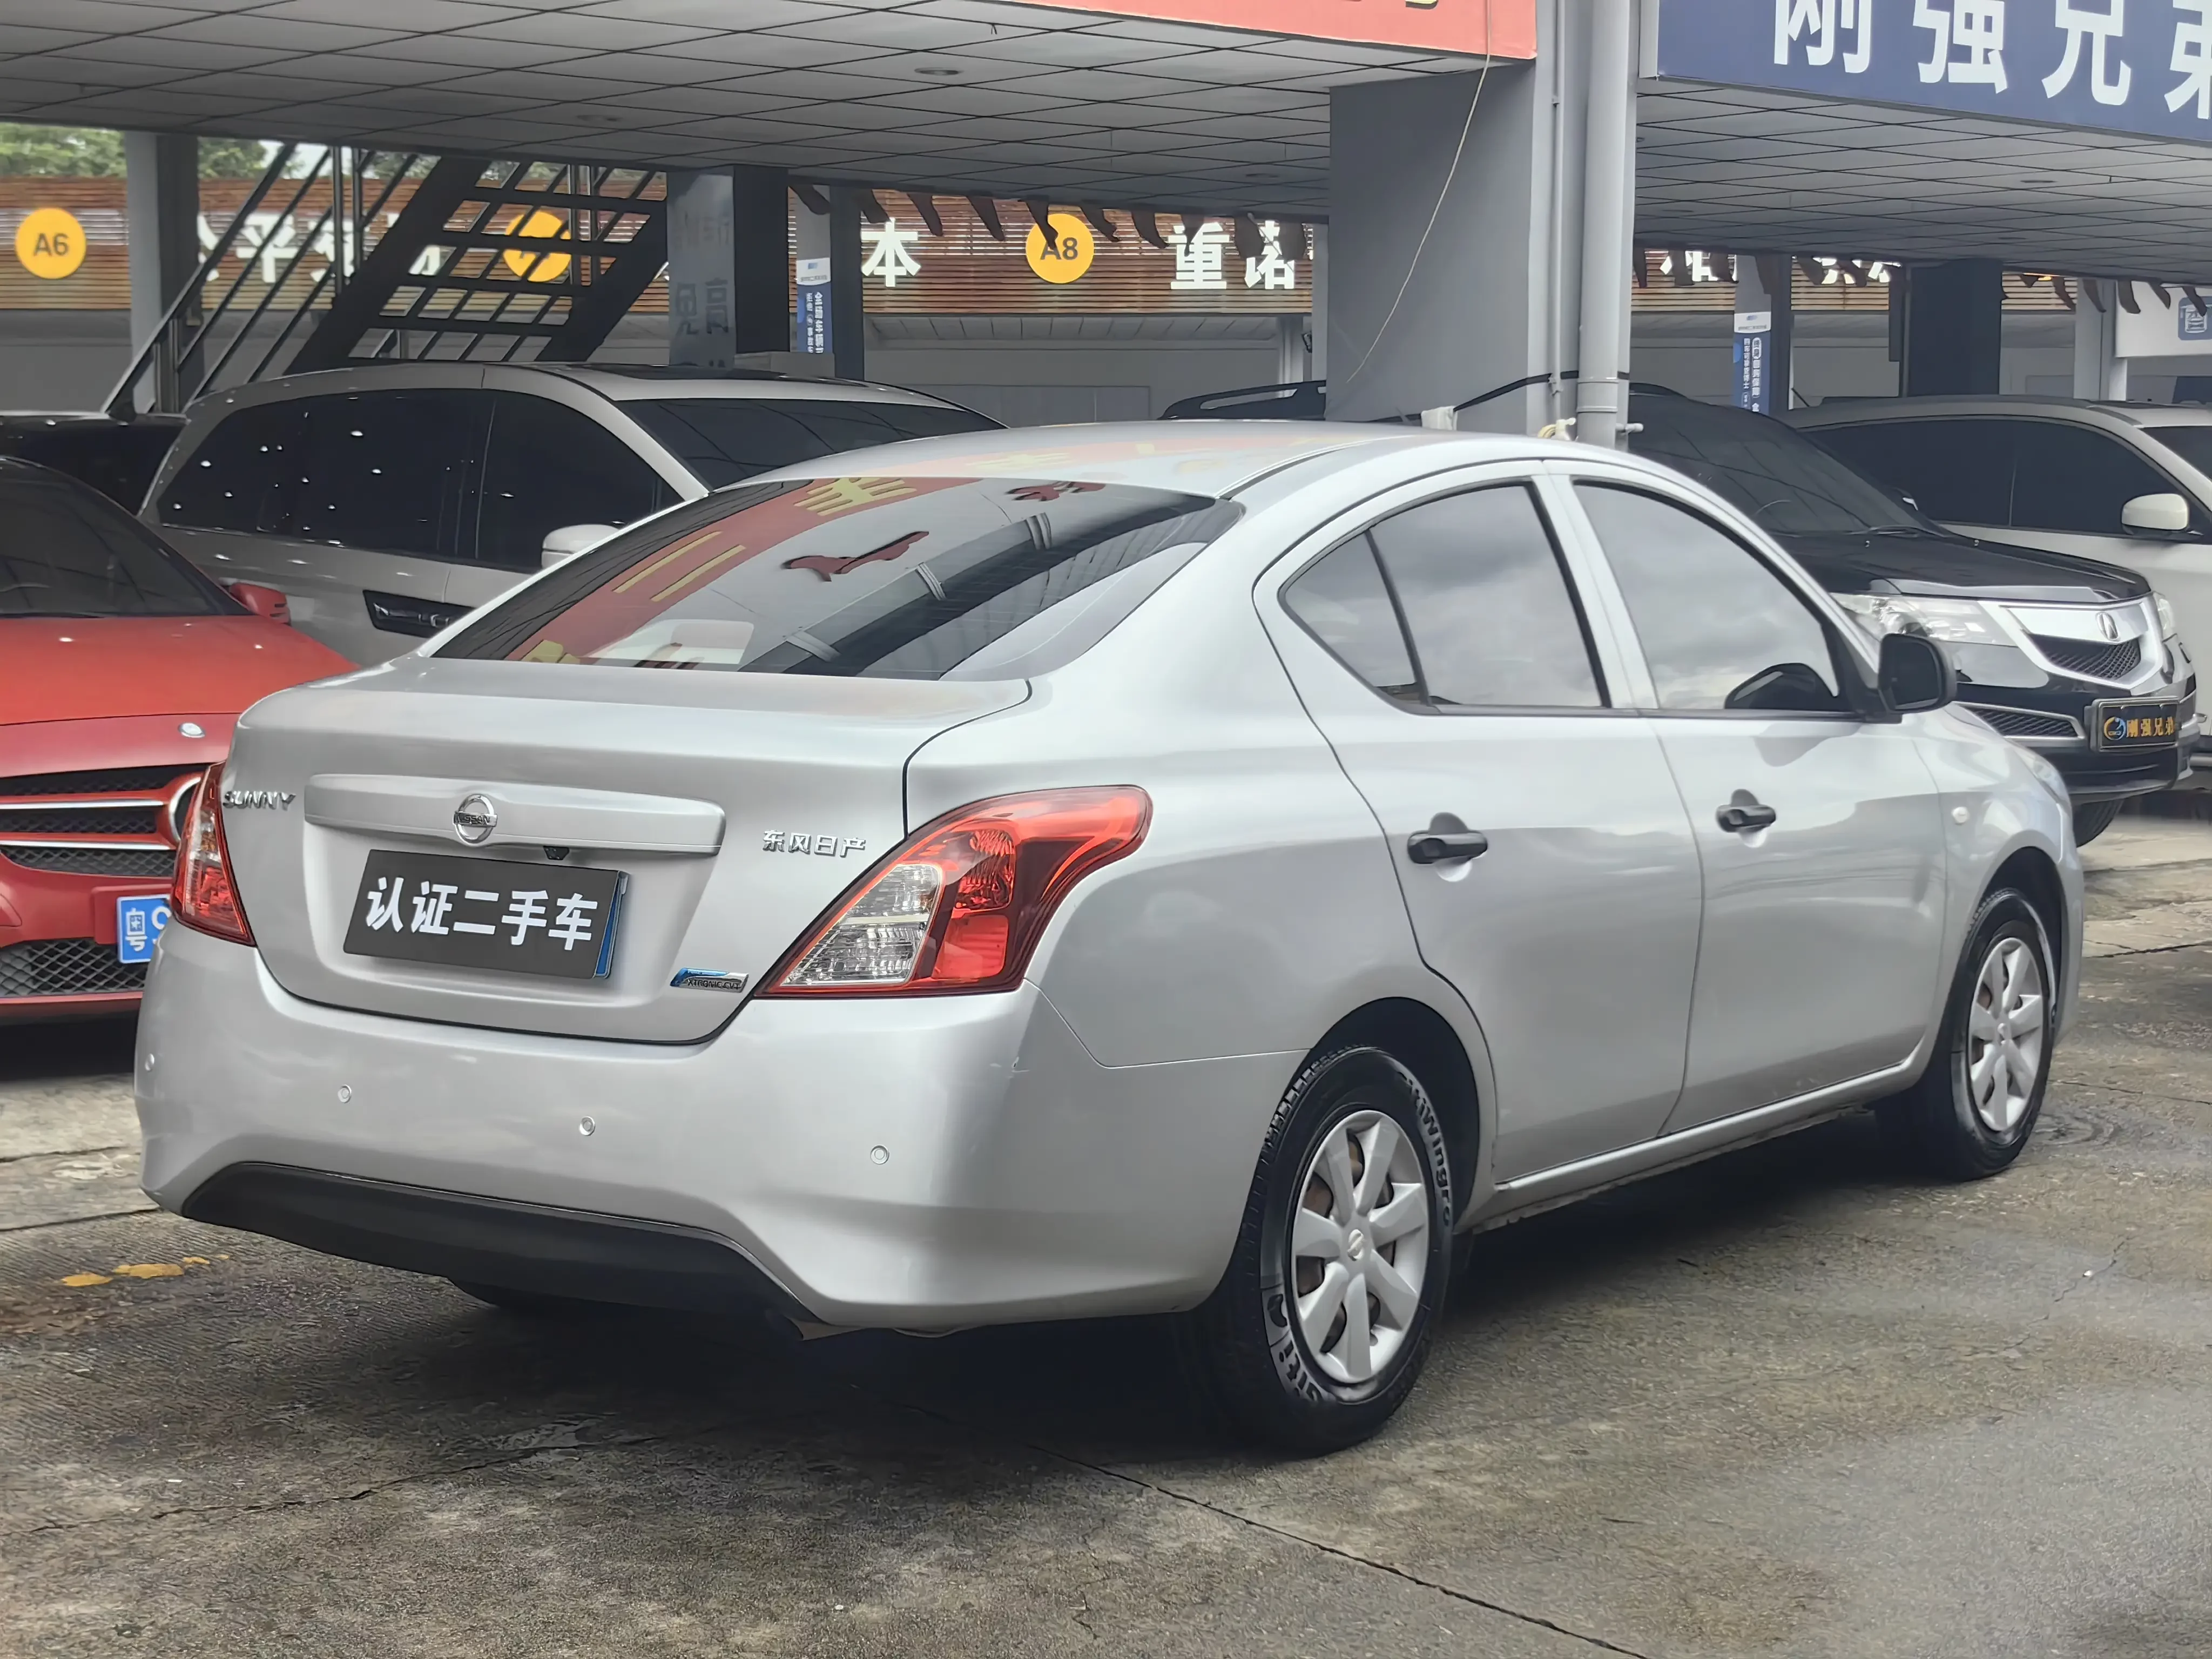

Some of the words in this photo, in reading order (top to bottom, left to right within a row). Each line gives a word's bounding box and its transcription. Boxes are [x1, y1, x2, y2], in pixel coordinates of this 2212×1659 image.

[33, 233, 70, 257] A6
[861, 218, 921, 287] 本
[1040, 237, 1078, 260] A8
[222, 791, 296, 811] SUNNY
[763, 830, 866, 858] 东风日产
[366, 876, 598, 951] 认证二手车
[687, 979, 721, 989] XTRONIC
[723, 982, 740, 990] CVT
